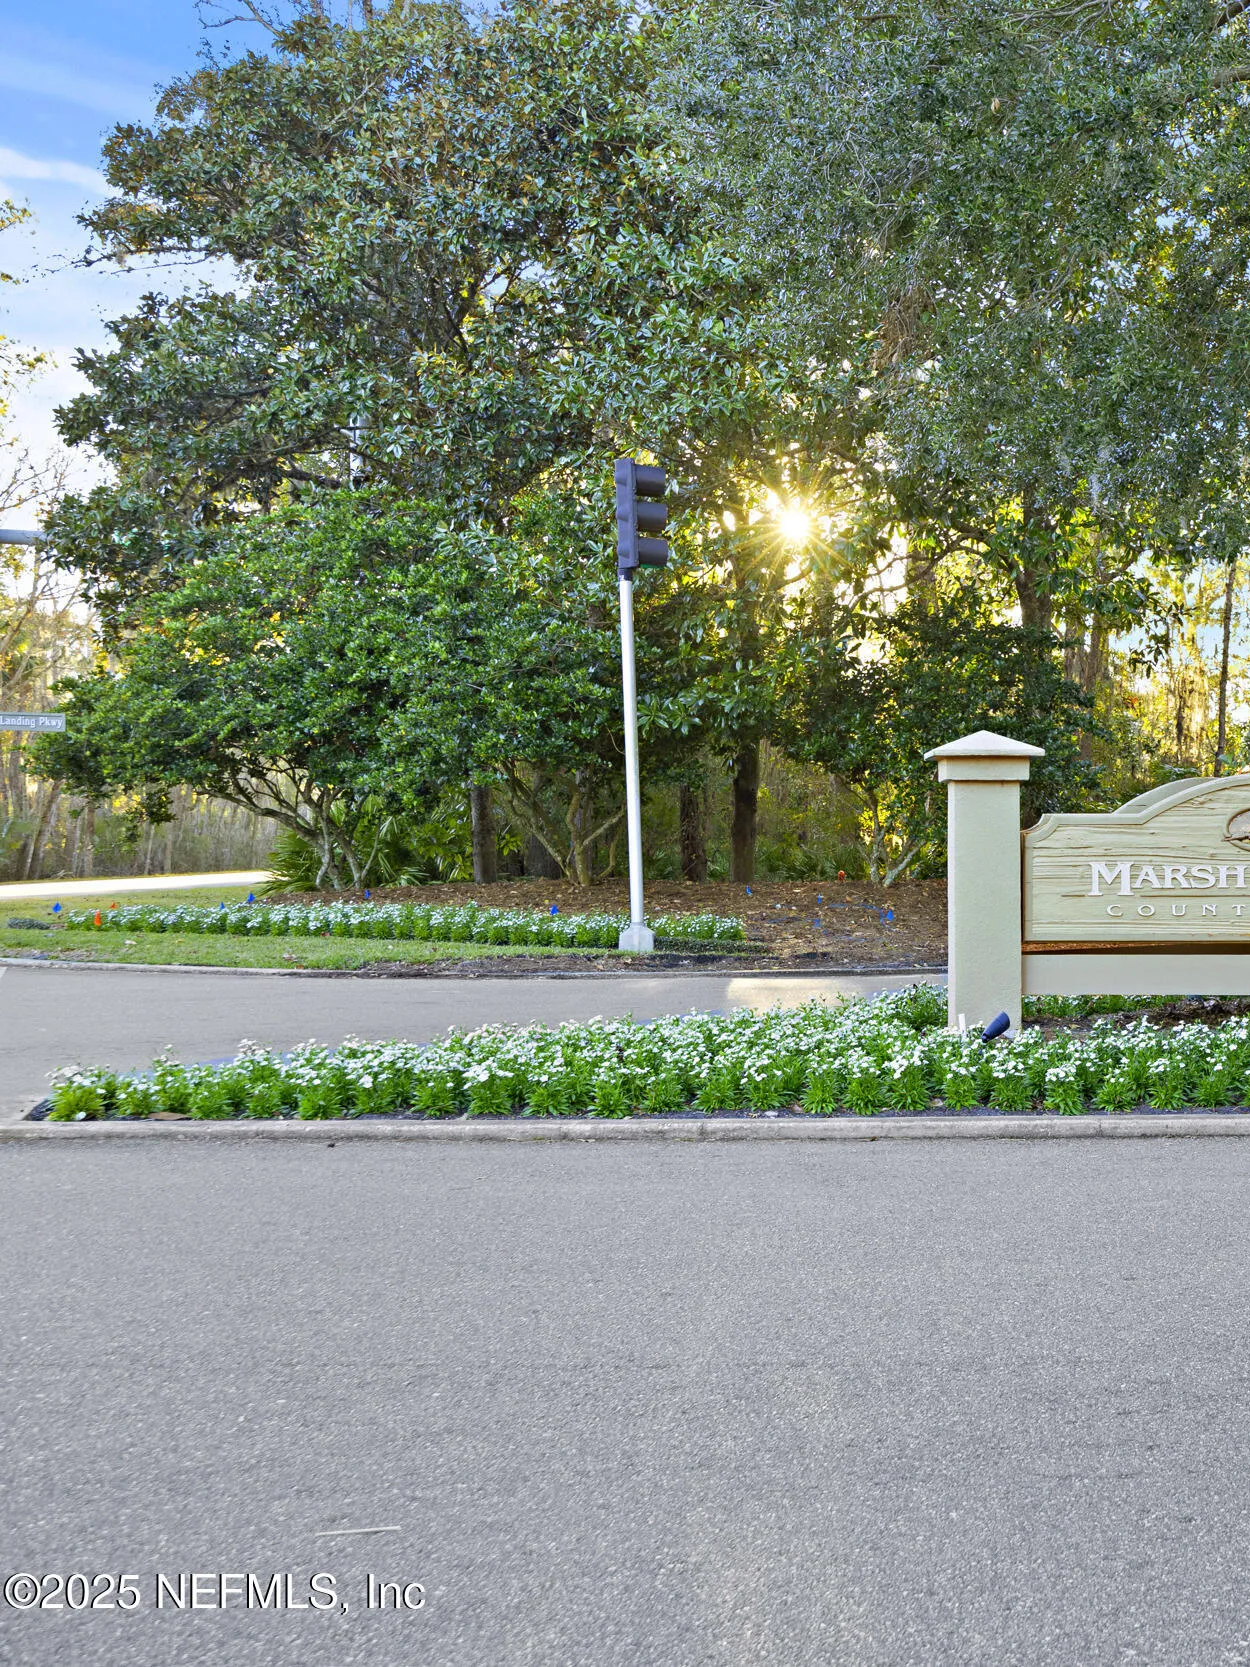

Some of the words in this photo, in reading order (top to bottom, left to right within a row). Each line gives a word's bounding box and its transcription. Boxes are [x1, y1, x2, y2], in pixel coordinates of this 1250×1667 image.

[0, 716, 36, 727] Landing
[39, 717, 63, 728] Pkwy
[1087, 861, 1248, 896] MARSH
